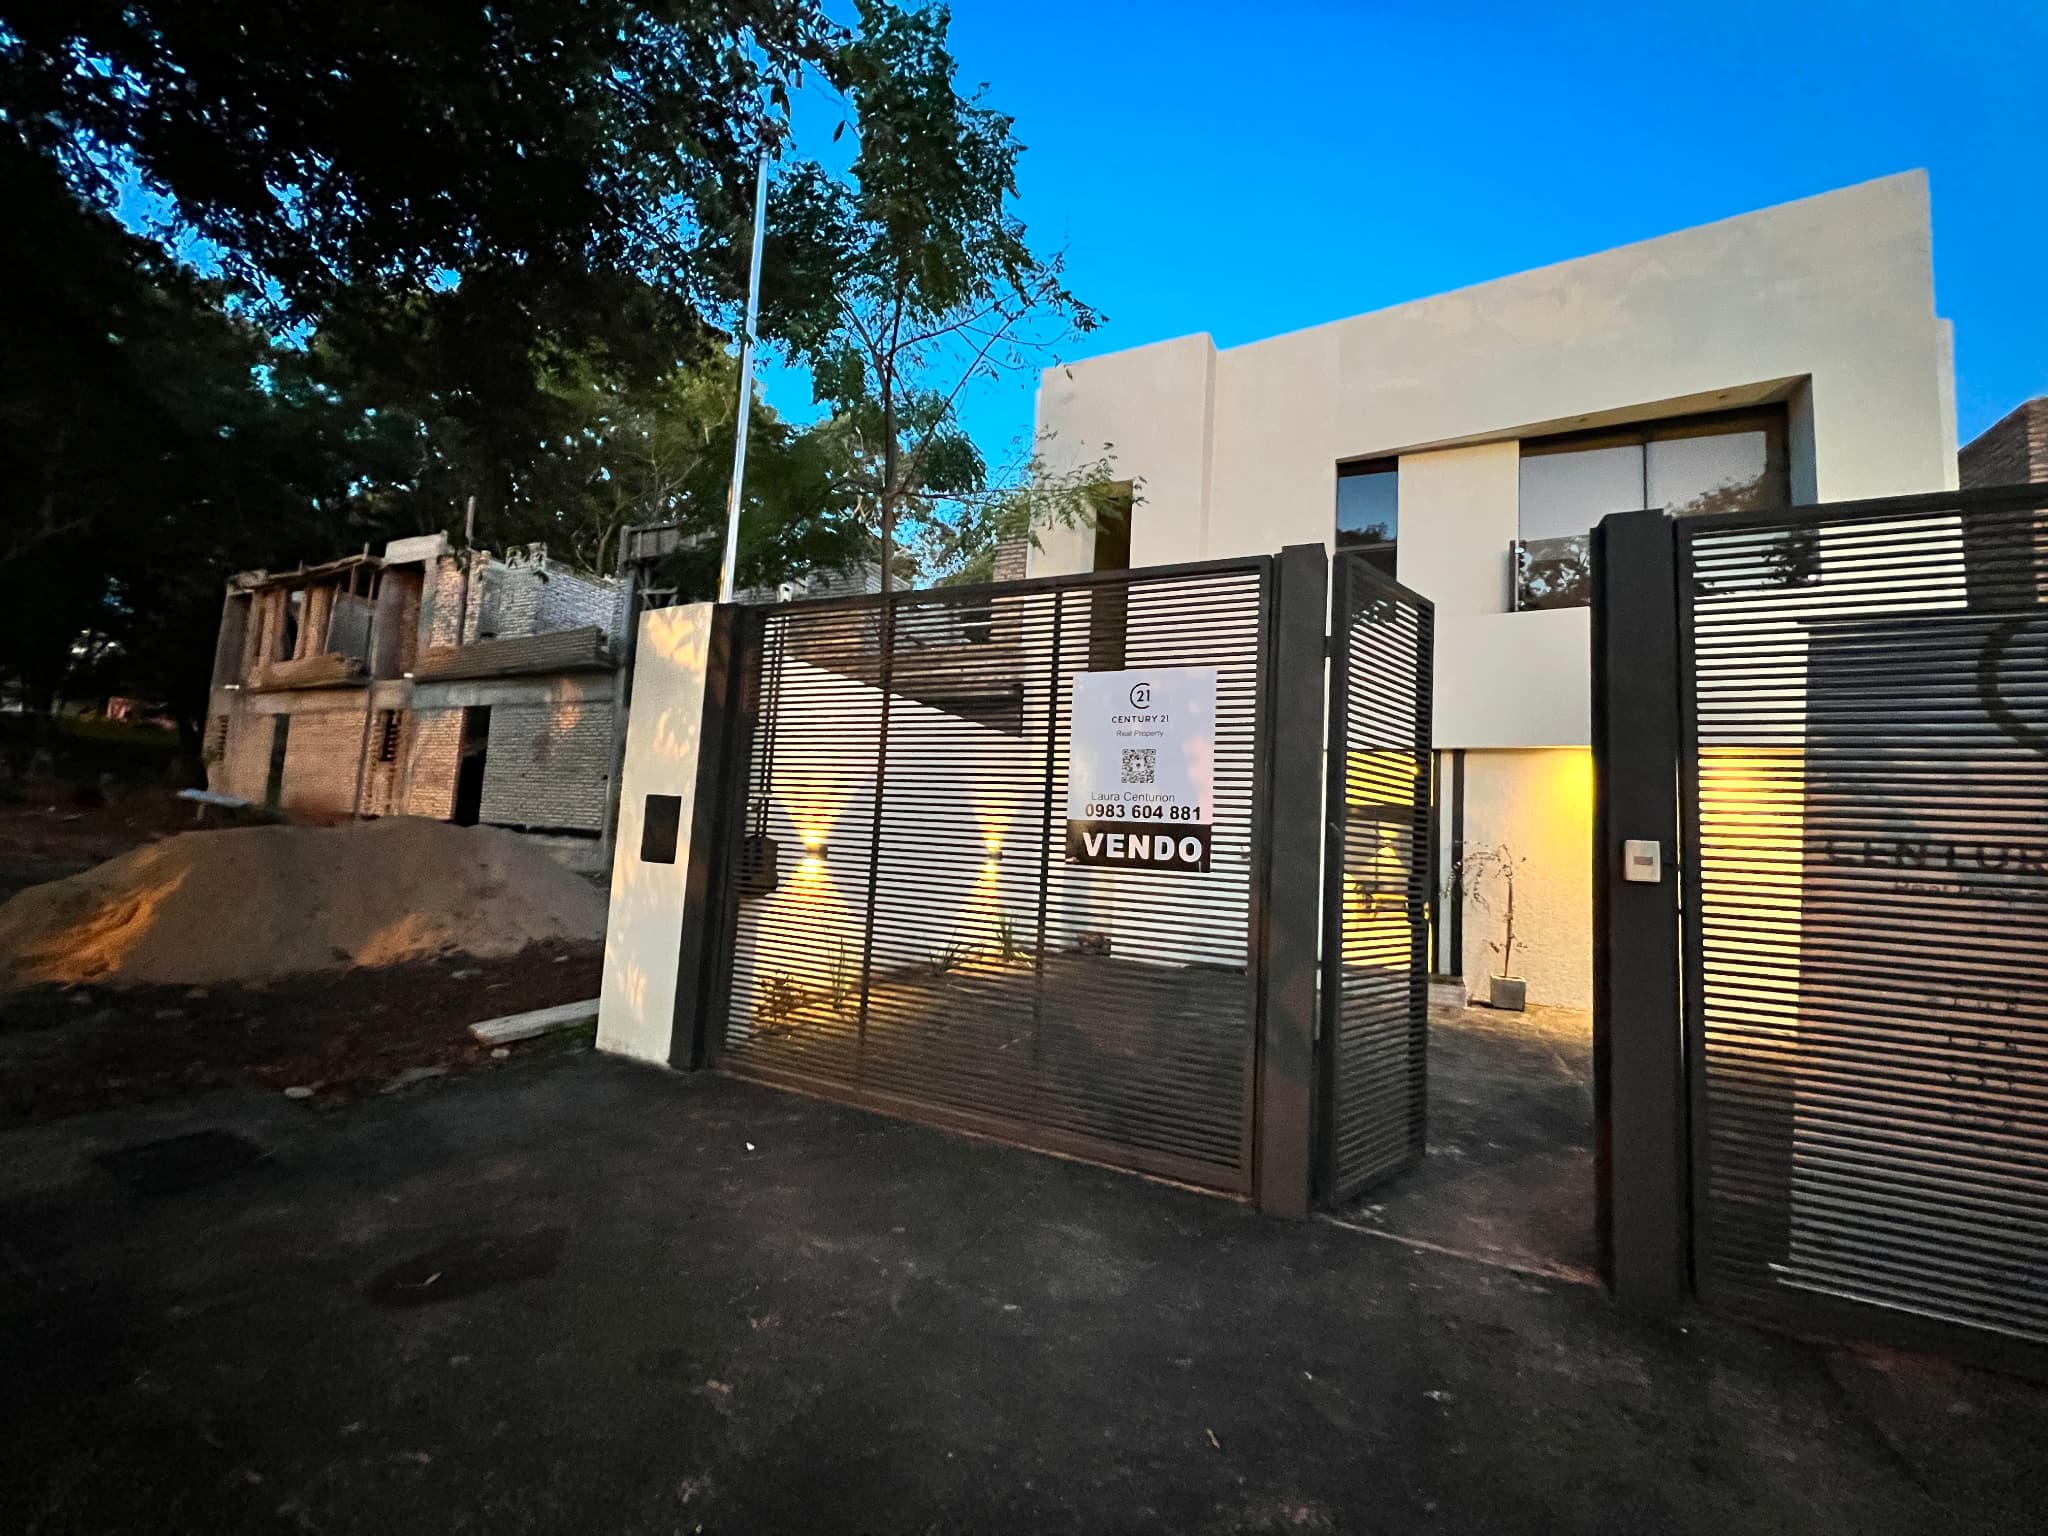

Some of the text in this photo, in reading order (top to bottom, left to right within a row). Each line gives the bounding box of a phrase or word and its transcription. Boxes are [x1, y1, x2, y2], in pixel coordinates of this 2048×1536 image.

[1111, 714, 1169, 724] CENTURY 21
[1116, 729, 1164, 738] Real Property
[1091, 791, 1120, 801] Laura
[1085, 803, 1200, 821] 0983 604 881
[1082, 832, 1202, 863] VENDO
